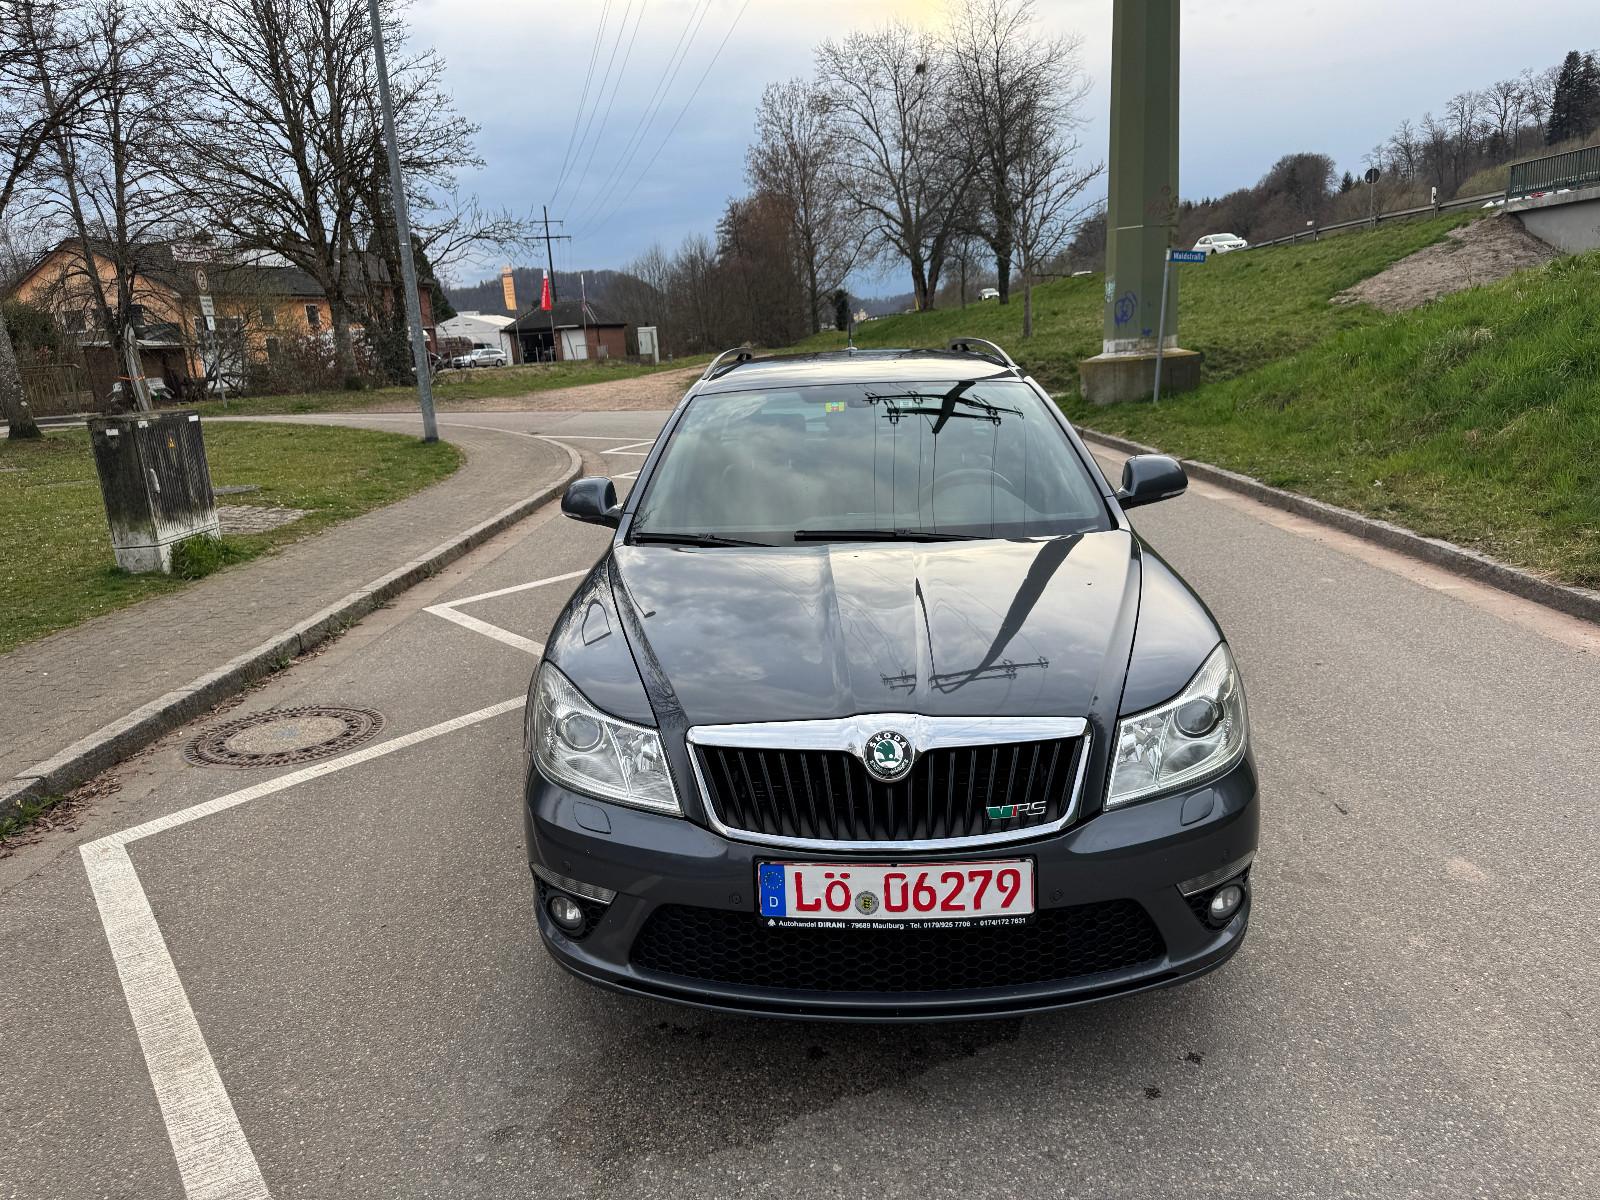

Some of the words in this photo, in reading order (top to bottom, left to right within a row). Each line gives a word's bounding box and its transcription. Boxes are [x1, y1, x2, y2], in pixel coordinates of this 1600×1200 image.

[1173, 251, 1205, 261] Waldstraße
[795, 871, 852, 912] LÖ
[884, 868, 1021, 913] 06279
[769, 896, 779, 908] D
[778, 920, 817, 928] Autohandel
[817, 921, 846, 929] DIRANI
[872, 922, 905, 930] Maulburg
